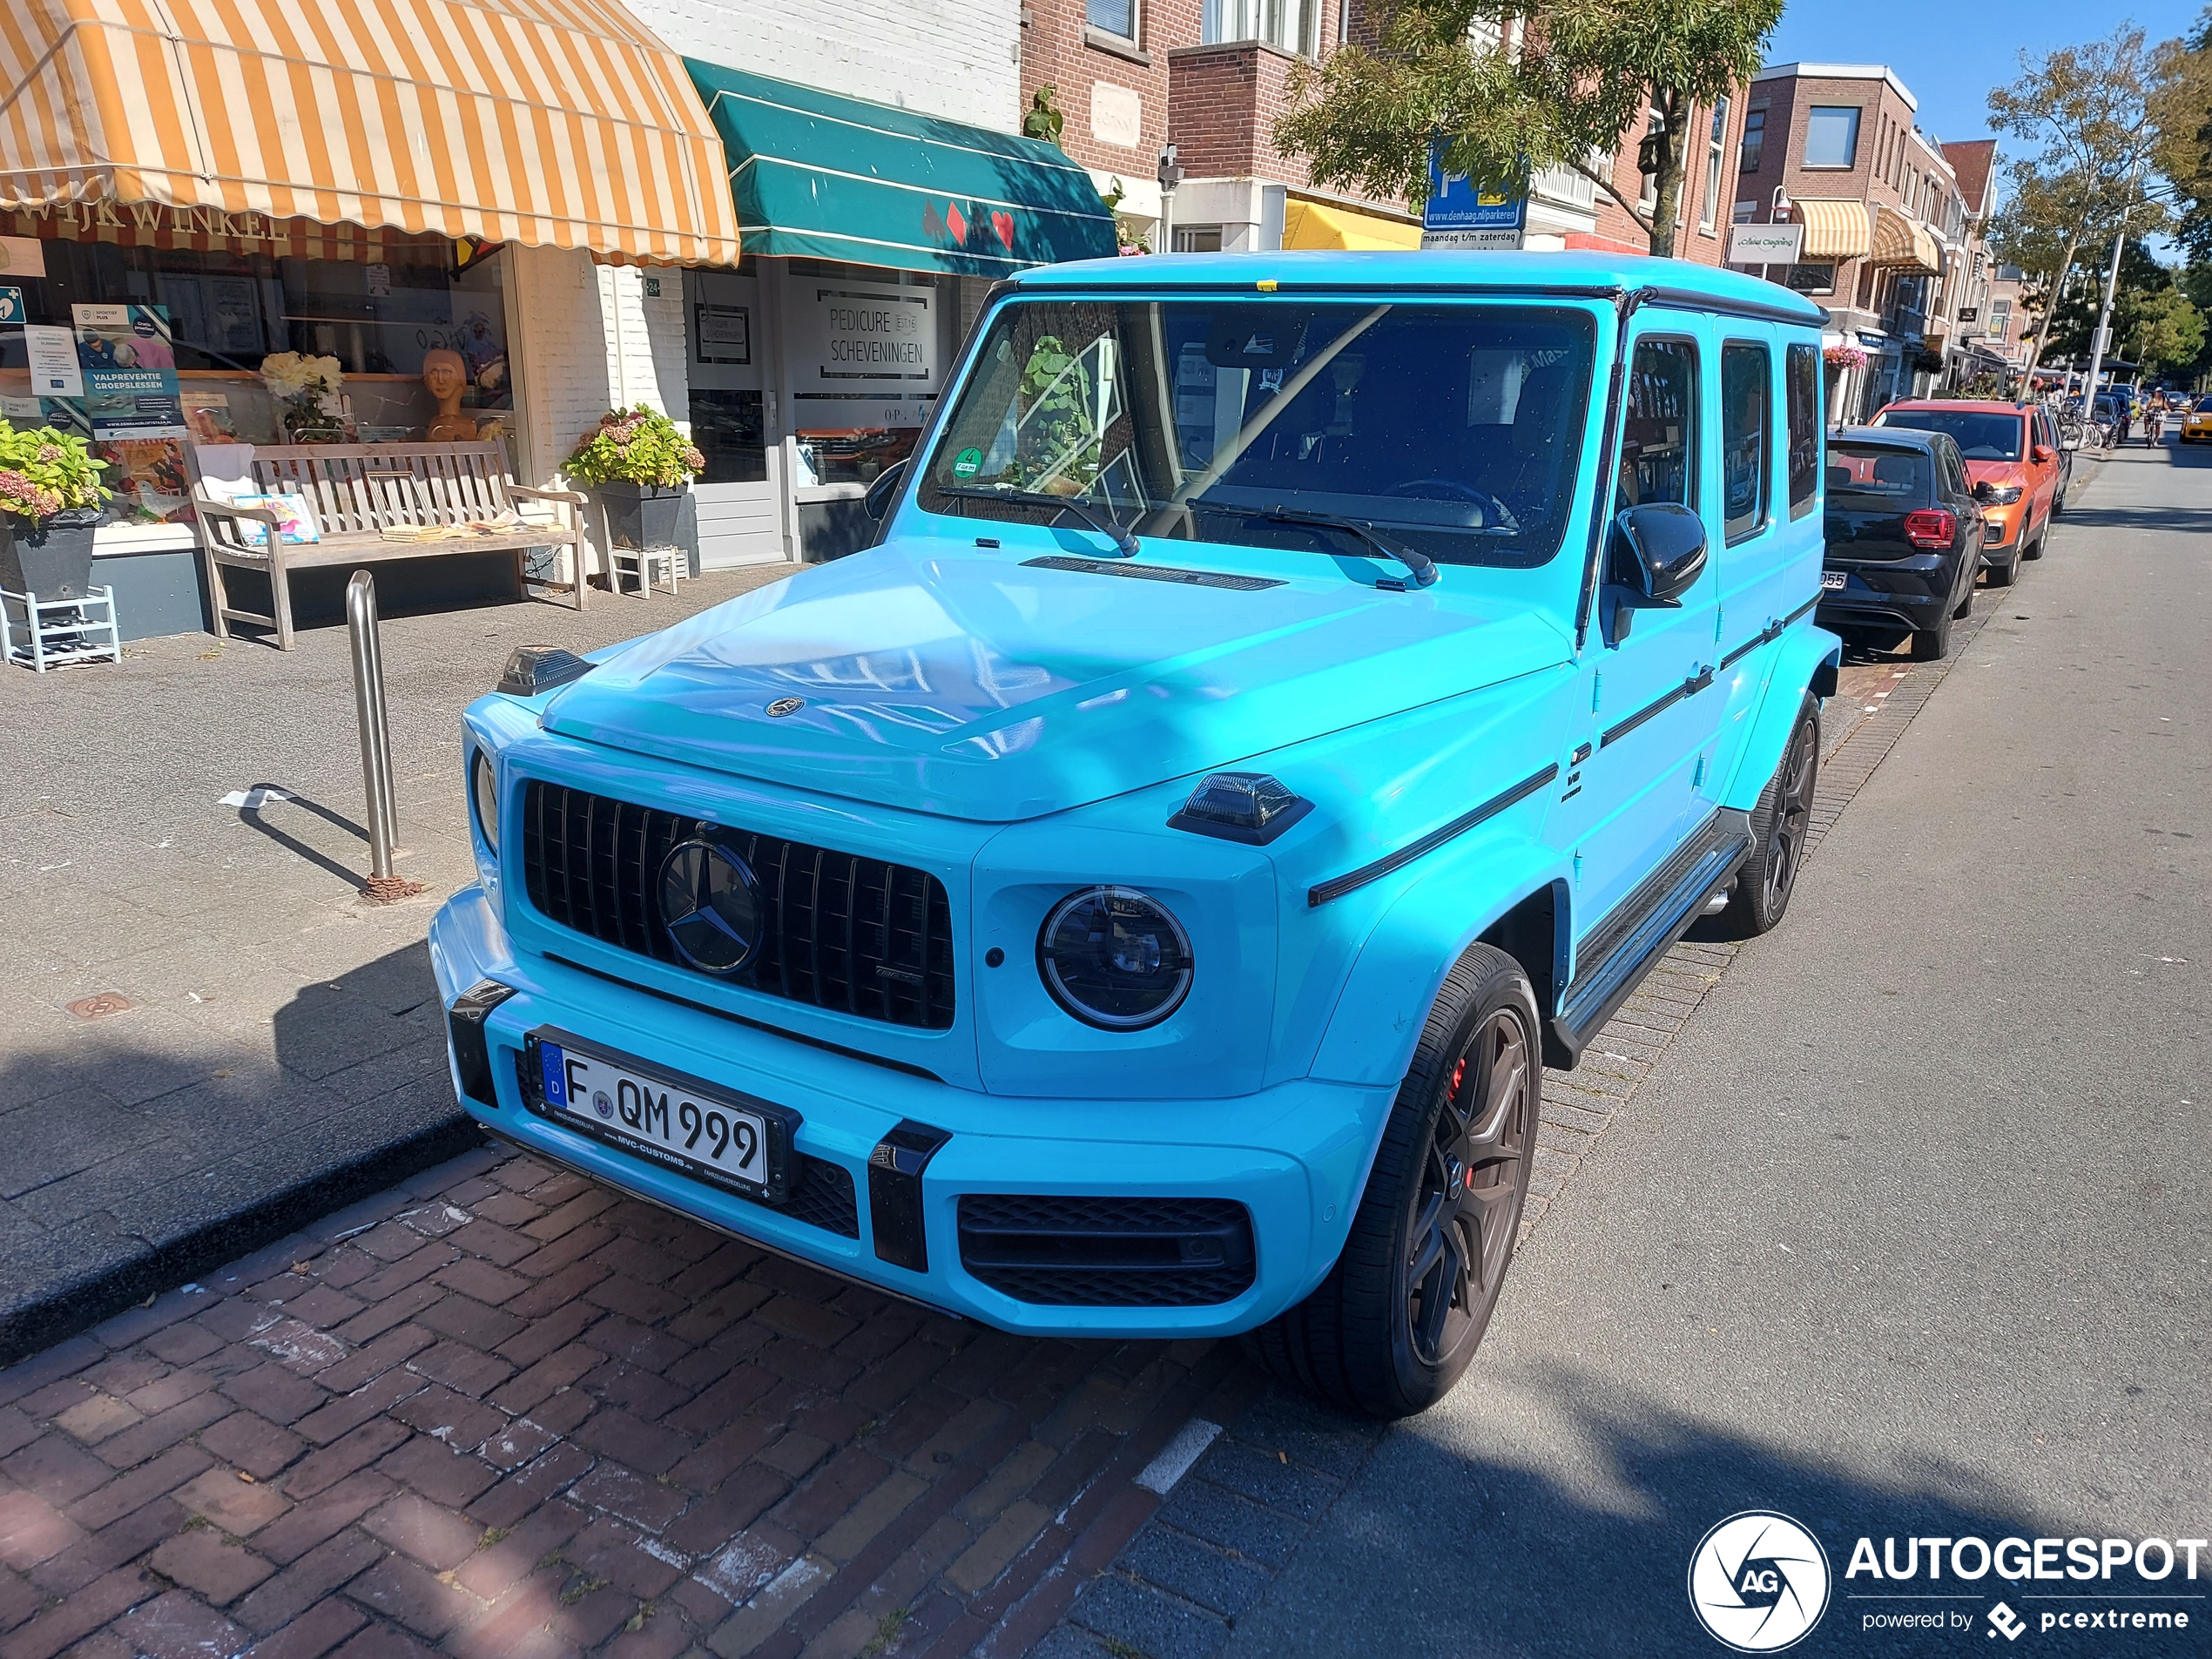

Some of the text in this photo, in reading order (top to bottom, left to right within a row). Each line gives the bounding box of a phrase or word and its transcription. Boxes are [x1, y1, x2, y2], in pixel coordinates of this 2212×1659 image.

[1428, 209, 1515, 223] www.denhaag.nl/parkeren
[1423, 233, 1515, 244] maandag t/m zaterdag
[649, 283, 658, 293] 24
[830, 309, 891, 332] PEDICURE
[831, 340, 923, 364] SCHEVENINGEN
[93, 373, 162, 381] VALPREVENTIE
[965, 448, 975, 463] 4
[551, 1080, 560, 1095] D
[565, 1058, 758, 1170] F QM 999
[604, 1131, 694, 1171] www.MVC-CUSTOMS.de
[704, 1169, 752, 1192] FAHRZEUGVEREDELUNG
